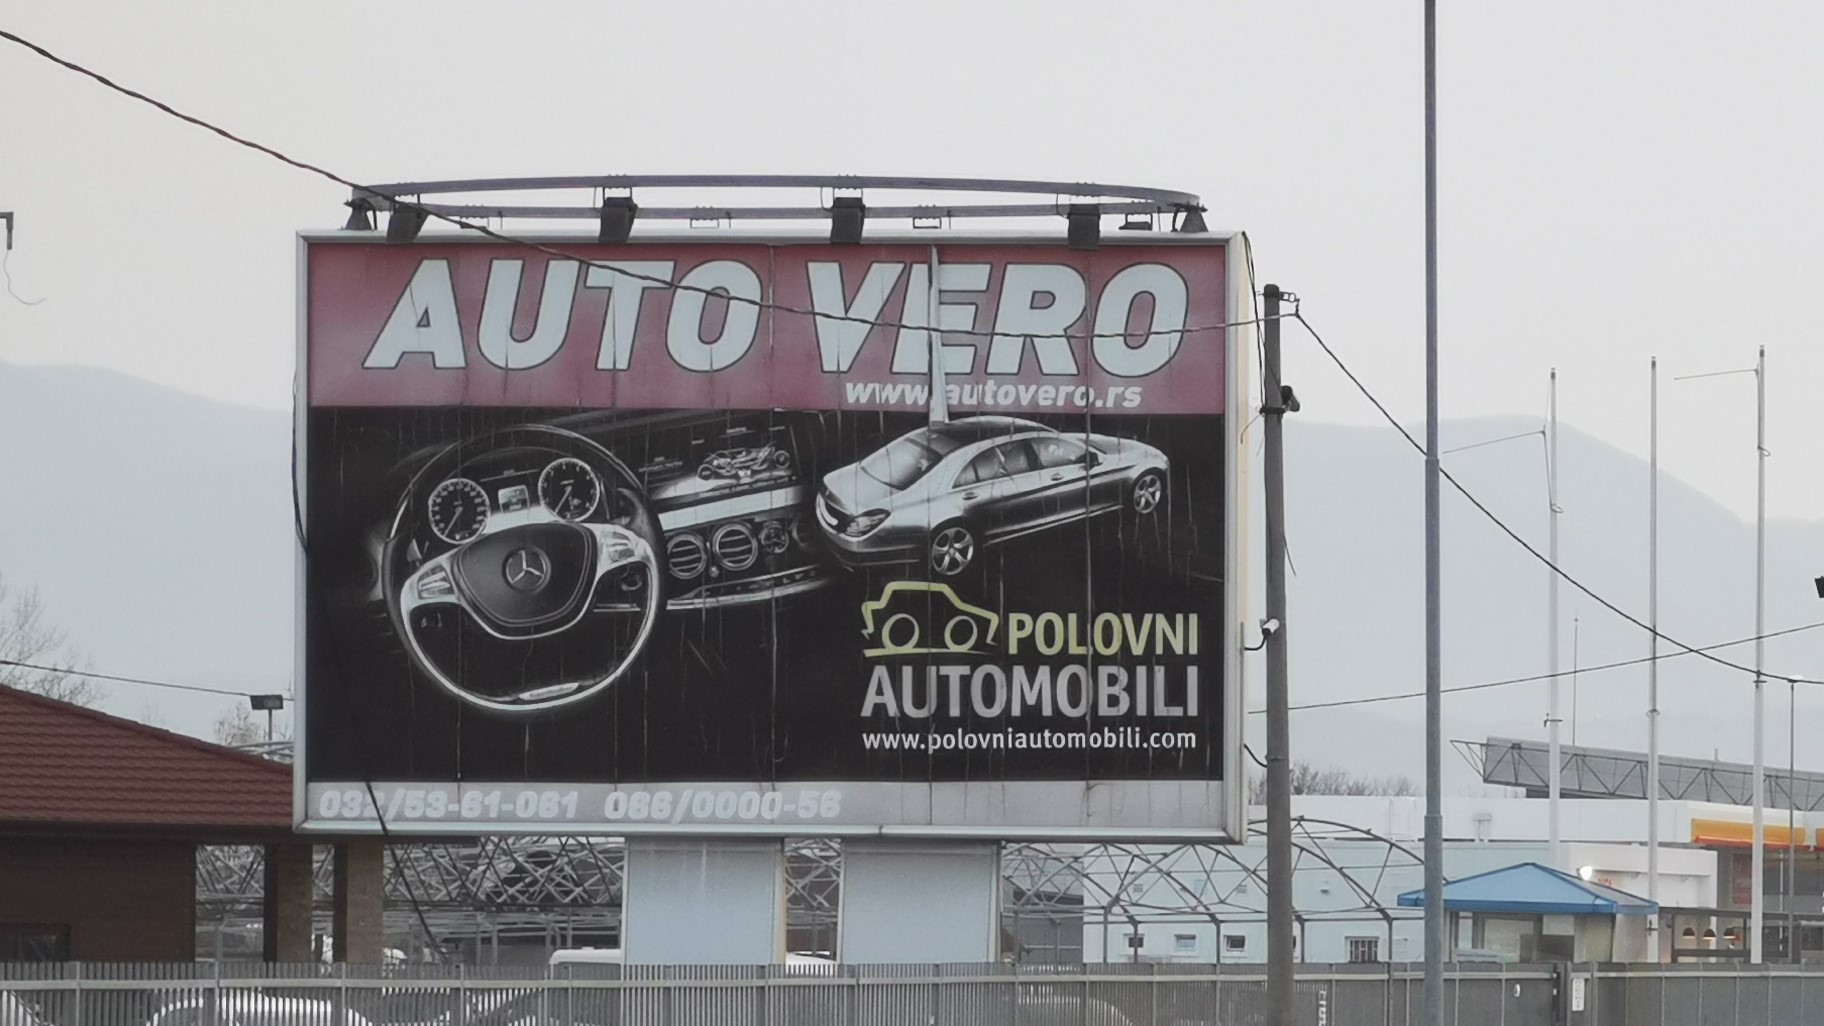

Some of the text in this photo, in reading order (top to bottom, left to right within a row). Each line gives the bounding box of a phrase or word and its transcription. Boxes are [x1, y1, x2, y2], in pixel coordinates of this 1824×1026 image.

[362, 258, 1190, 378] AUTO VERO
[1008, 612, 1199, 656] POLOVNI
[860, 664, 1199, 718] AUTOMOBILI
[862, 727, 1197, 751] www.polovniautomobili.com
